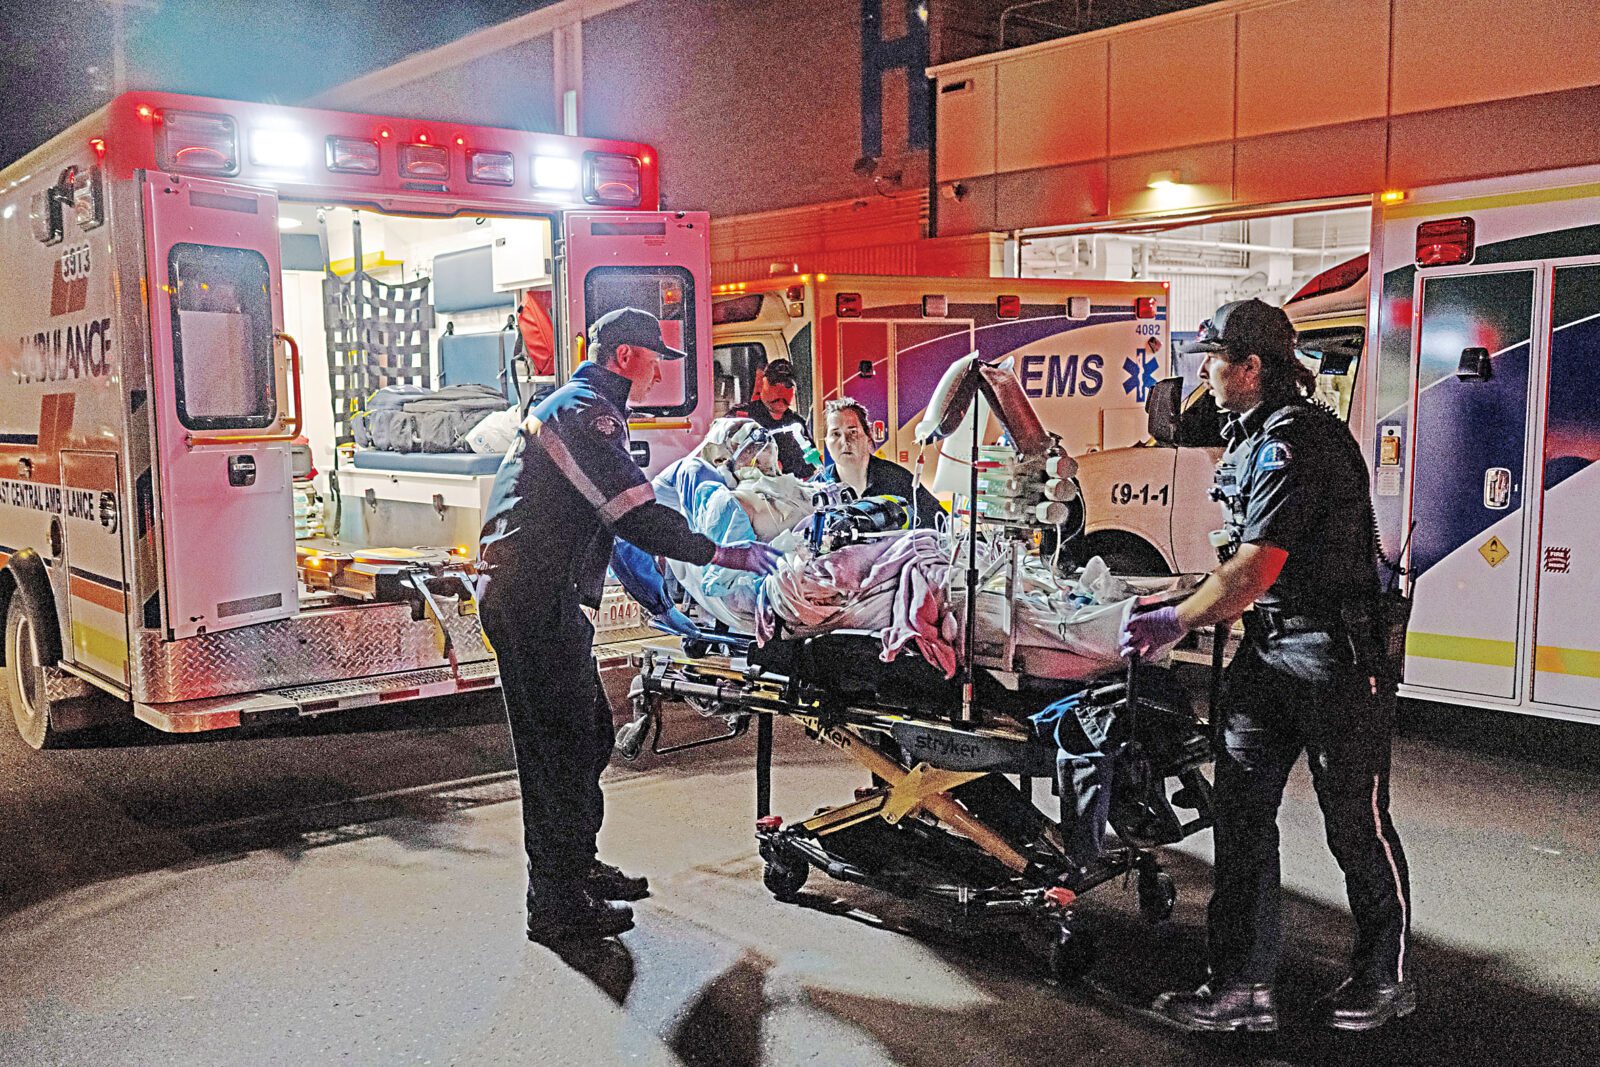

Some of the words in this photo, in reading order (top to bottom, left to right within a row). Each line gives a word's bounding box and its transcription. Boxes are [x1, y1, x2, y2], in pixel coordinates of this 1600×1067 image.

[1136, 324, 1160, 336] 4082
[18, 318, 111, 384] BULANCE
[1019, 354, 1104, 399] EMS
[12, 482, 43, 511] CENTRAL
[1111, 483, 1168, 506] (9-1-1
[915, 733, 981, 758] stryker
